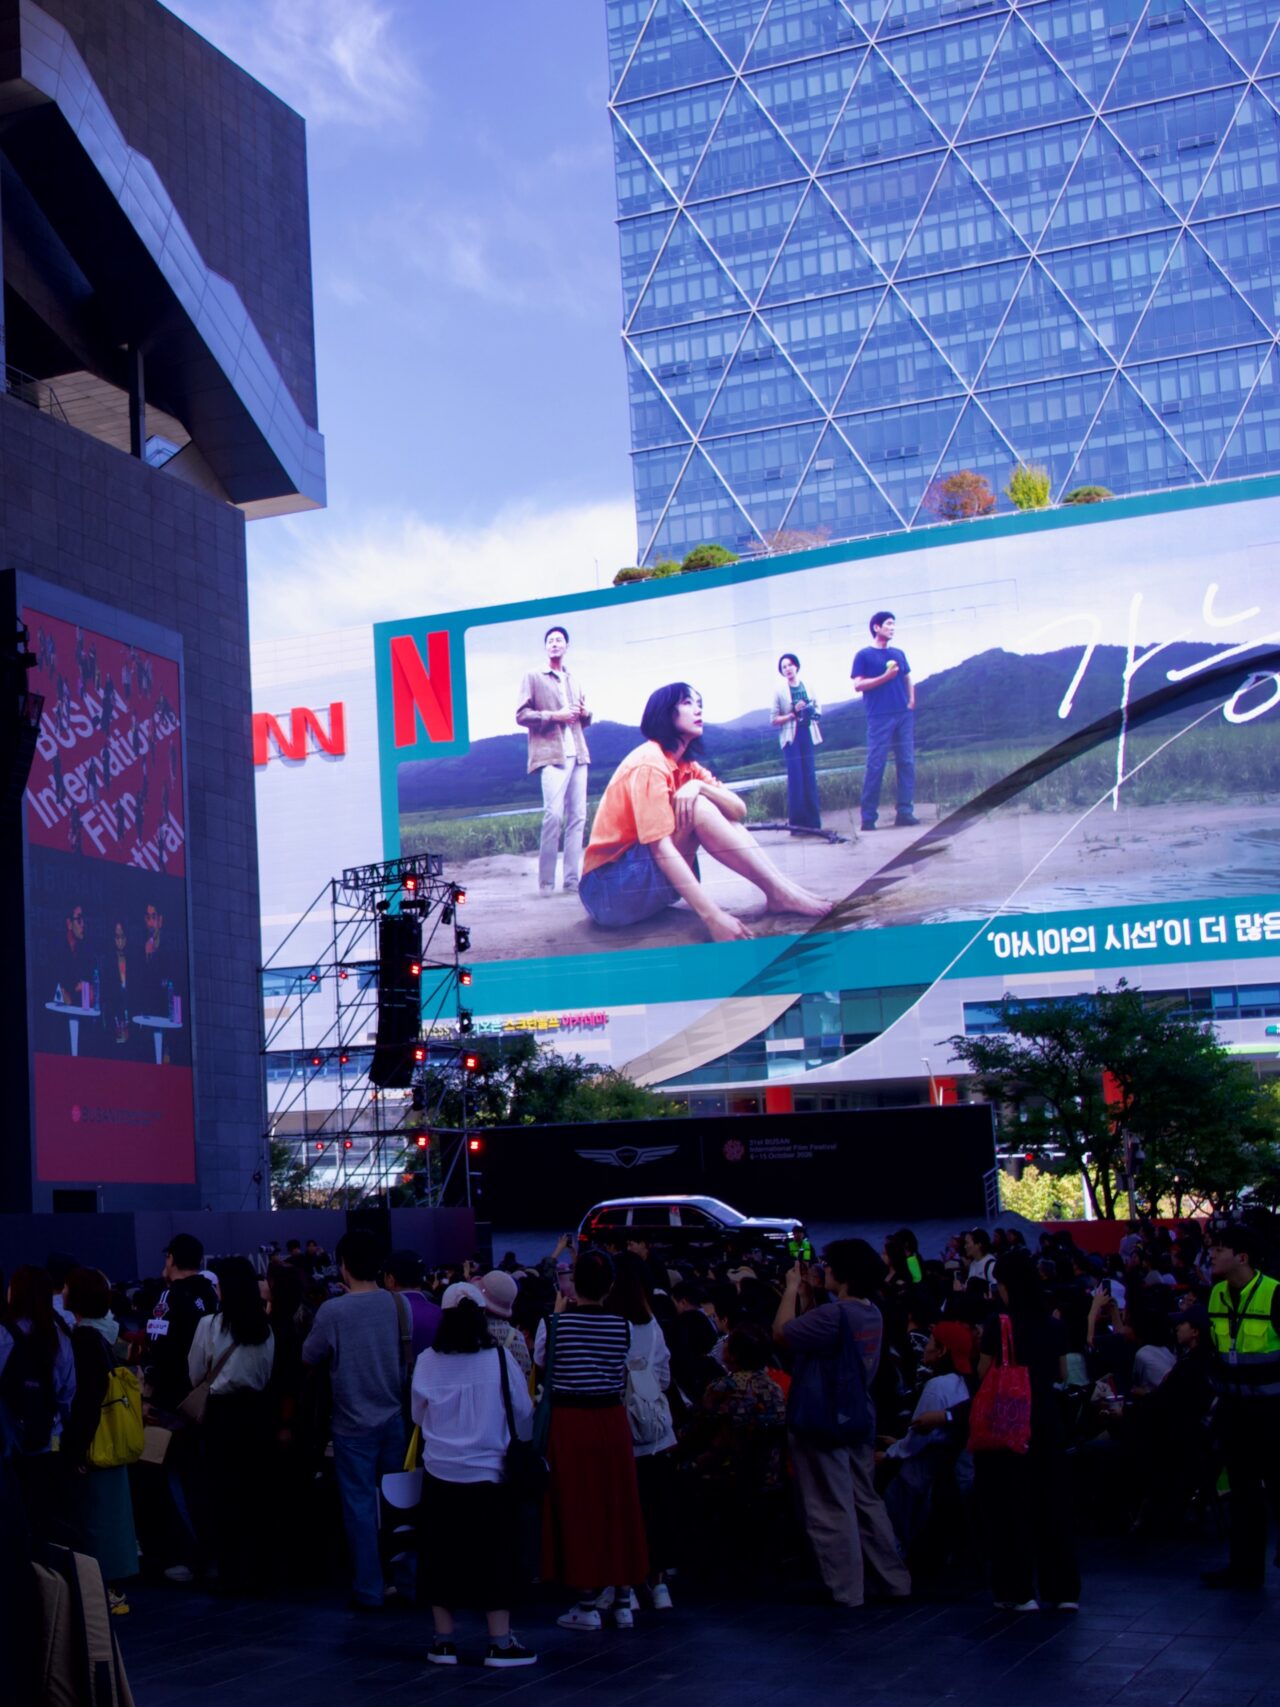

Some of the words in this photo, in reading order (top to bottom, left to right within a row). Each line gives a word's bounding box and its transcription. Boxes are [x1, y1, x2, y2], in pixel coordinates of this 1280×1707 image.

[390, 630, 455, 749] N
[36, 688, 129, 762] BUSAN
[252, 702, 345, 766] NN
[26, 710, 181, 829] Internationa
[80, 792, 138, 855] Film
[127, 811, 185, 872] tival
[1199, 915, 1227, 944] 더
[1234, 911, 1280, 942] 많은
